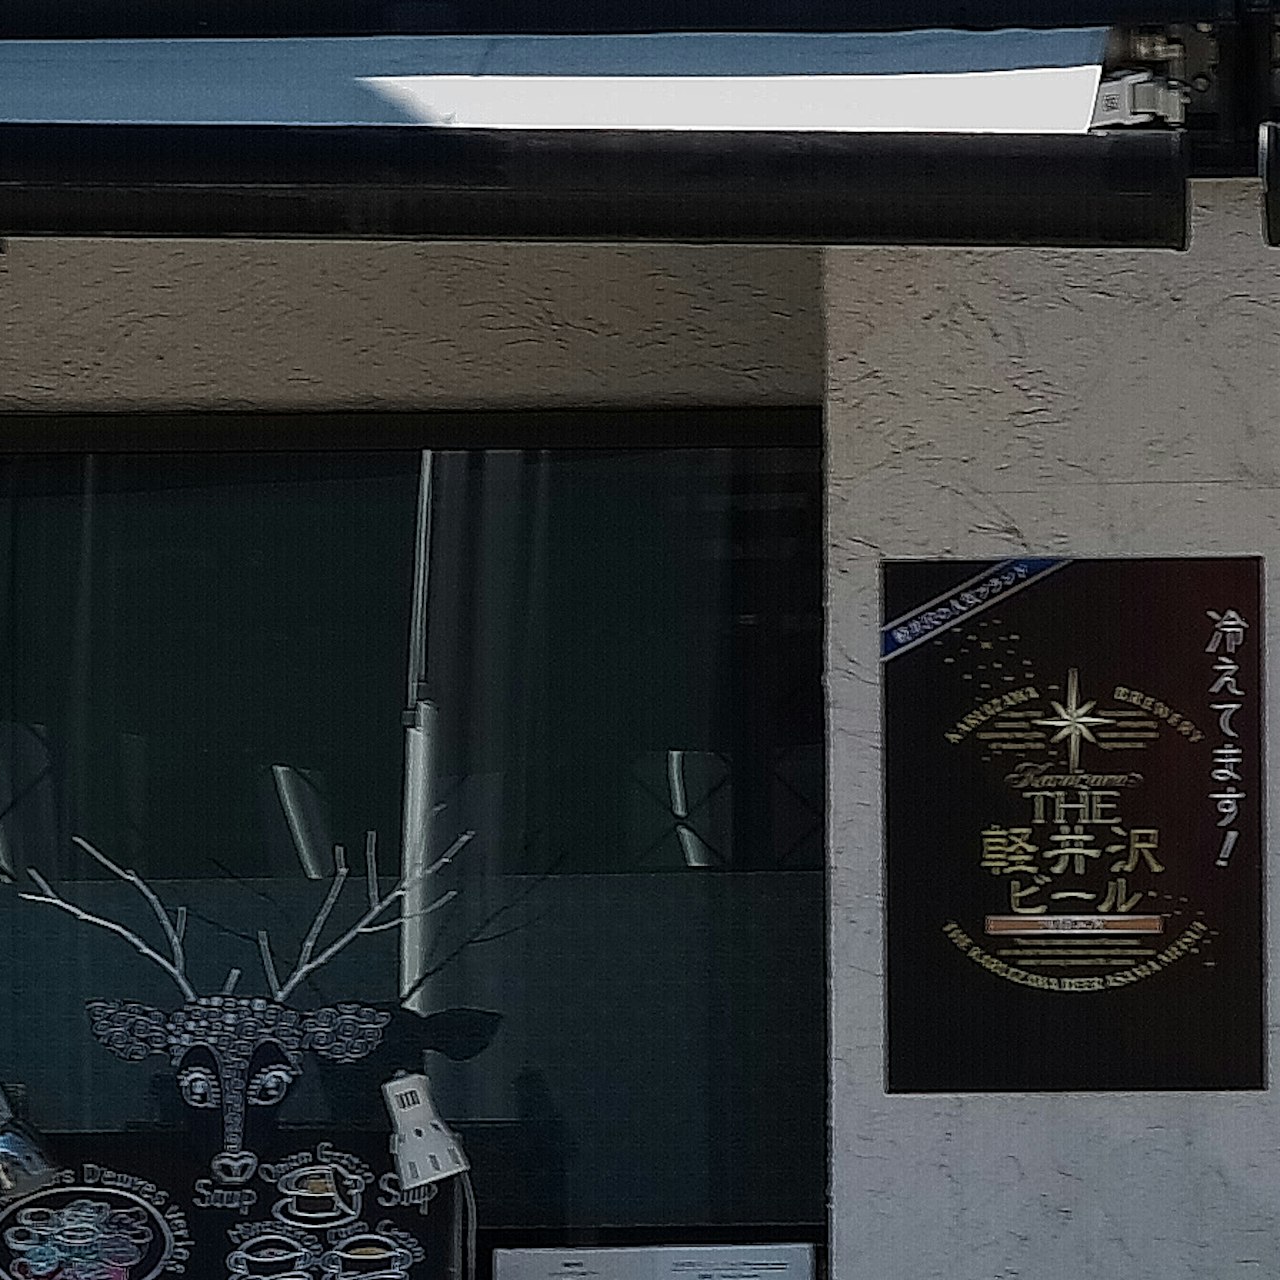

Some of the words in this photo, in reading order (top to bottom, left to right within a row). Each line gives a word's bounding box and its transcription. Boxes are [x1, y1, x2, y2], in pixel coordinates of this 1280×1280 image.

[1204, 608, 1249, 868] 冷えてます！
[1022, 791, 1122, 824] THE
[980, 825, 1166, 875] 軽井沢
[1010, 874, 1143, 914] ビール
